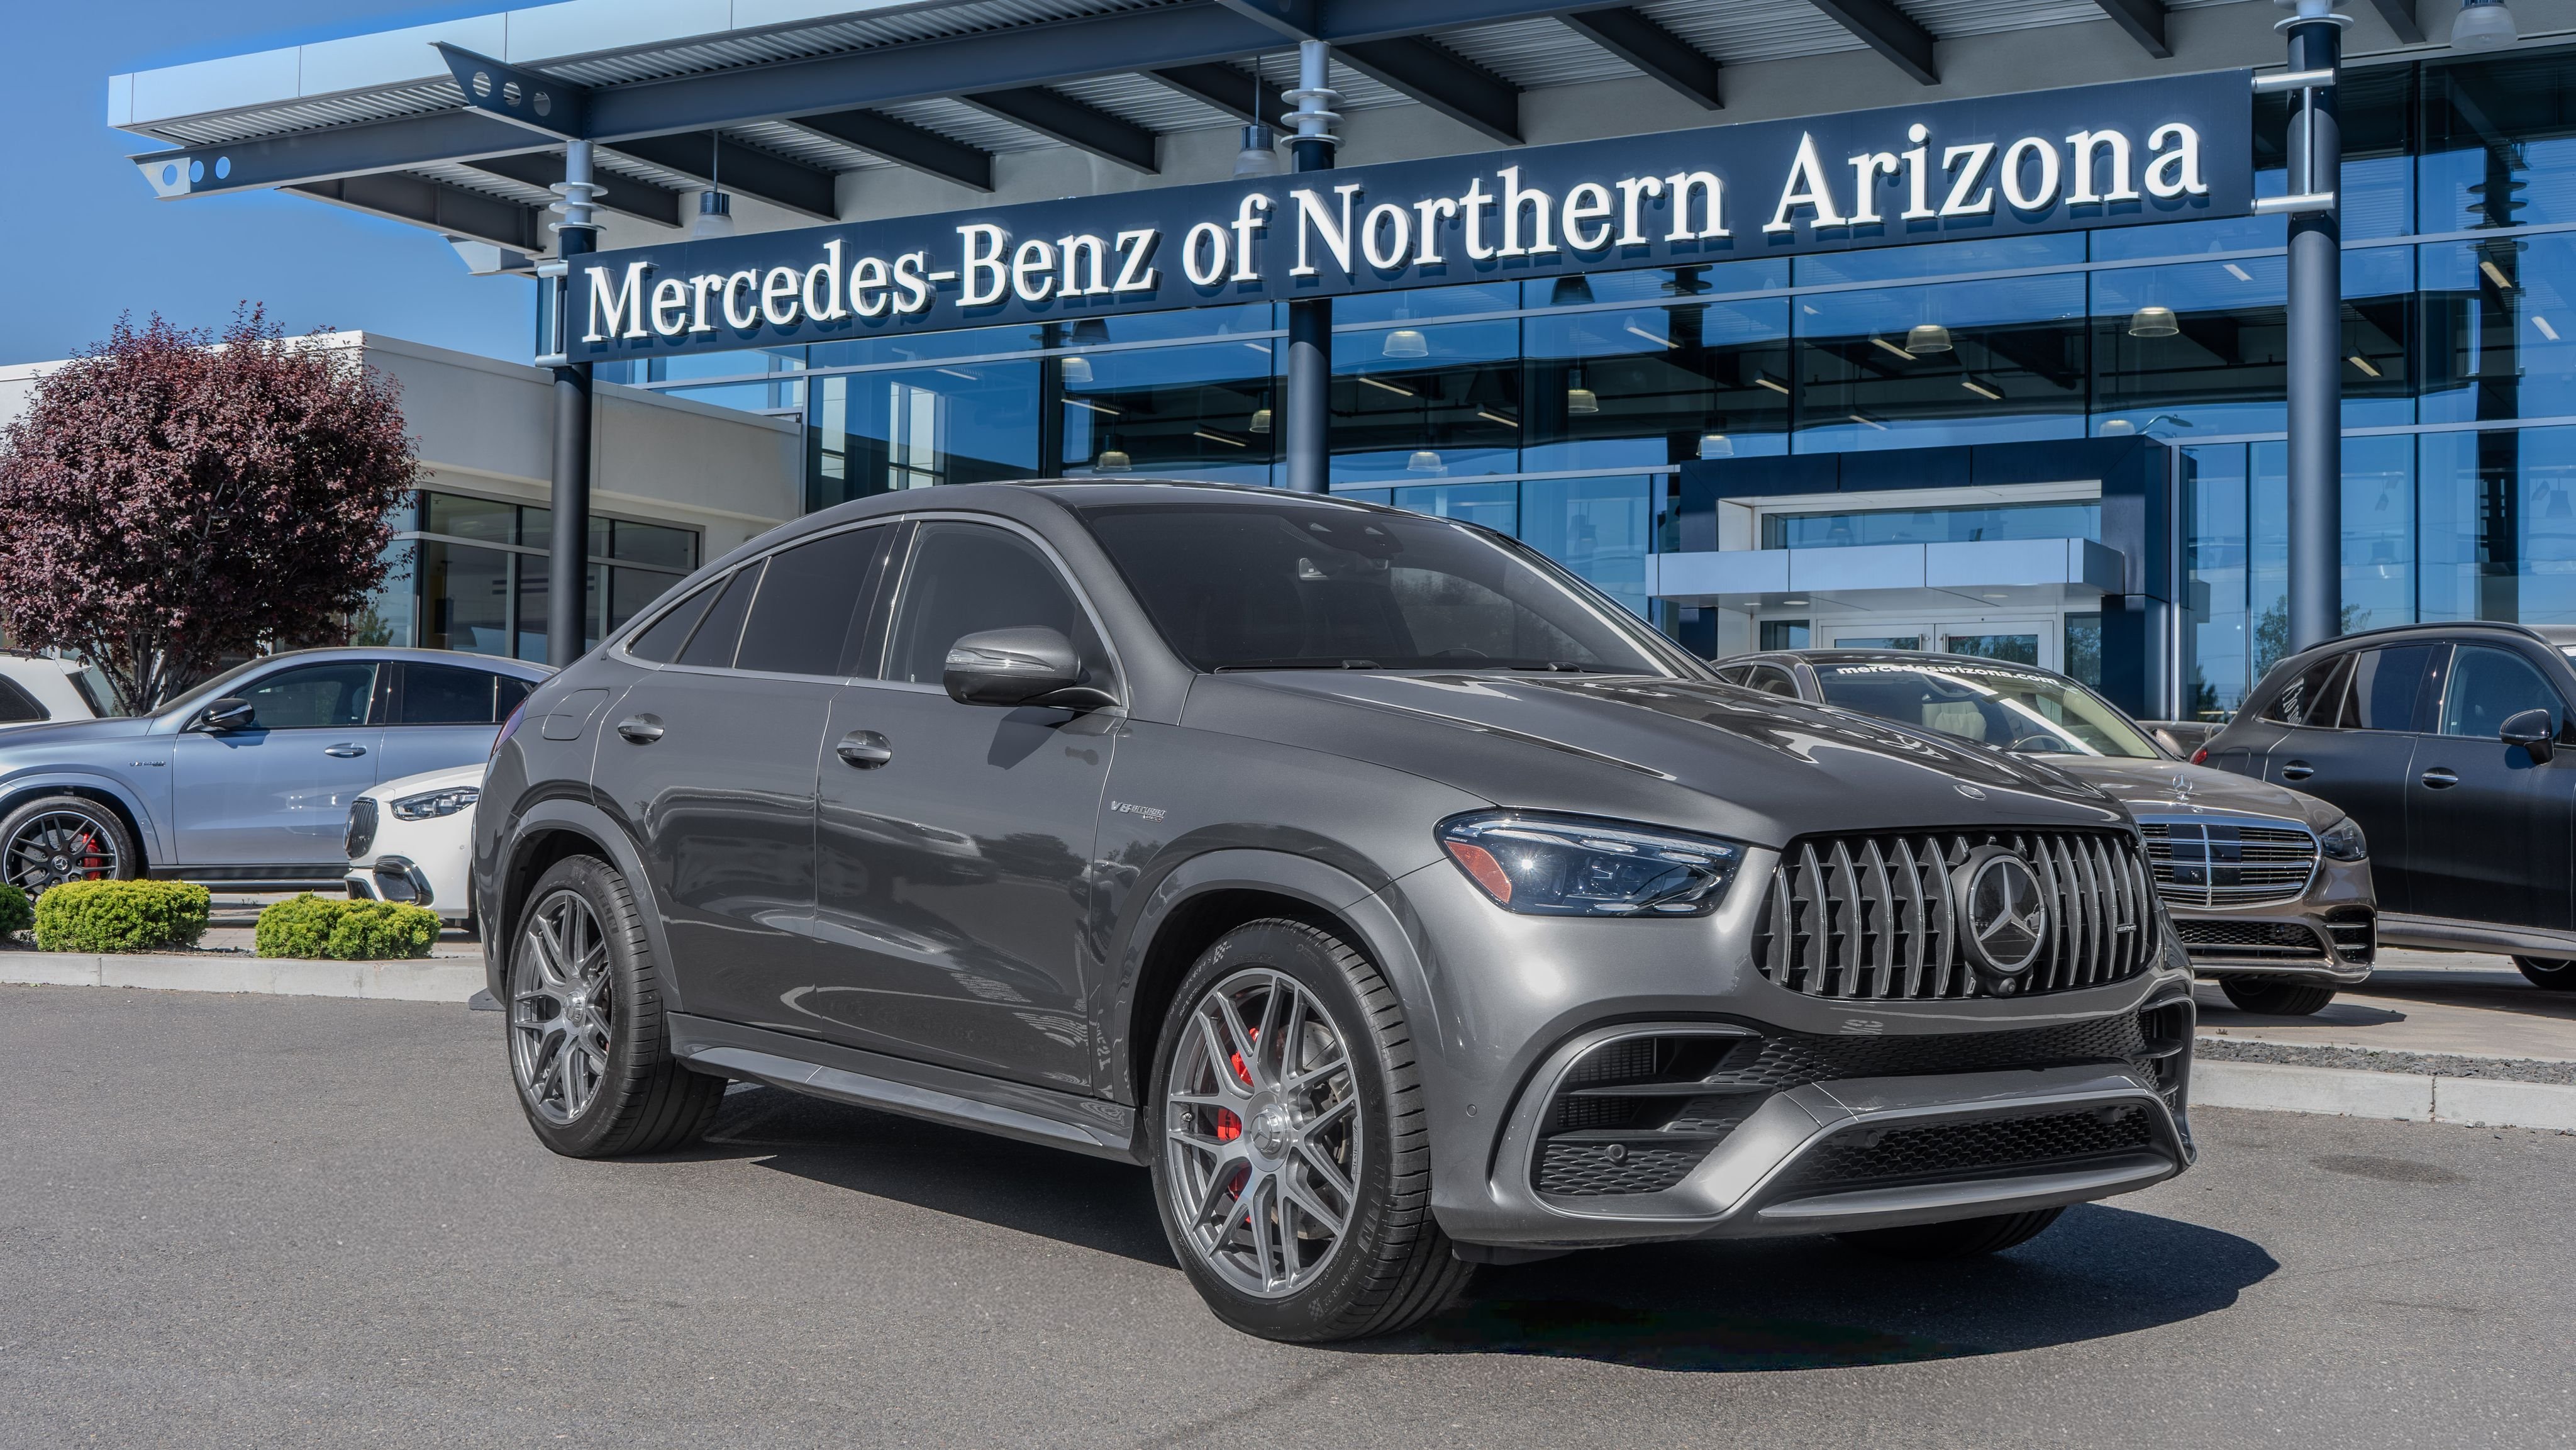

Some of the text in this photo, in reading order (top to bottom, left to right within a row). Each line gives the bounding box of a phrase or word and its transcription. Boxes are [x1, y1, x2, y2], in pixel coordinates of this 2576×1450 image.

[581, 122, 2209, 343] Mercedes-Benz of Northern Arizona
[1836, 665, 2060, 686] mercedesarizona.com
